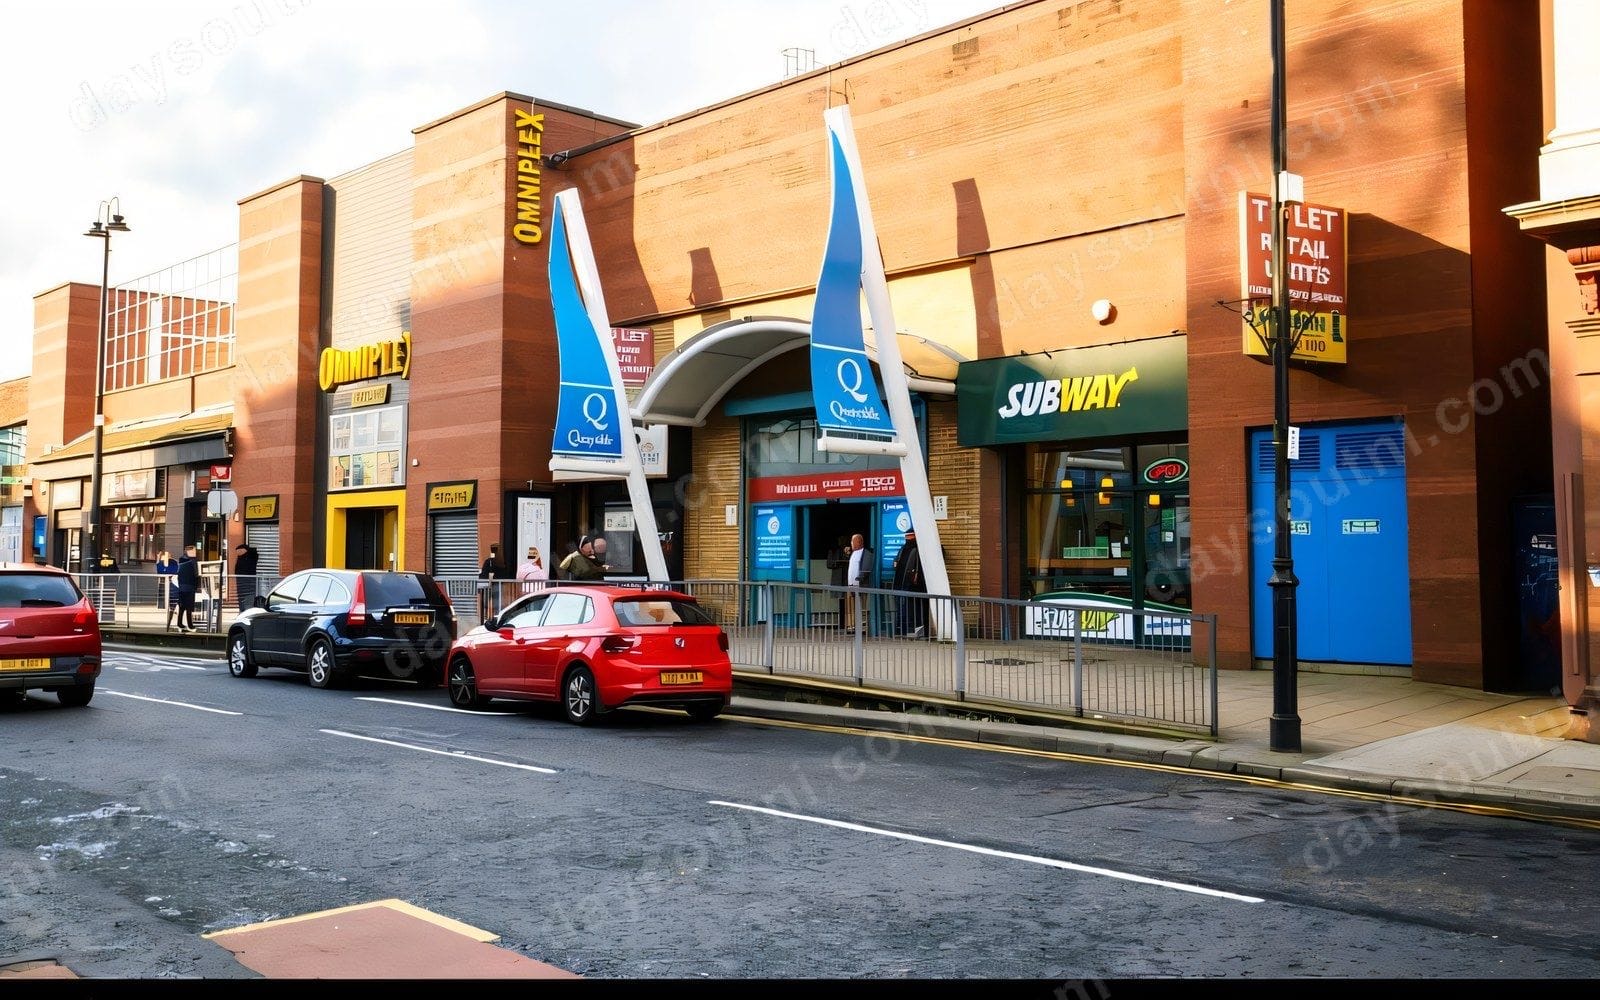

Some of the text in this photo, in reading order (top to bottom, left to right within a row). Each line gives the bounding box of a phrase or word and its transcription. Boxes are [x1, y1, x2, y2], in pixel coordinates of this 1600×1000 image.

[513, 108, 545, 243] OMNIPLEX
[1294, 204, 1338, 232] LET
[1261, 232, 1329, 259] RTAIL
[837, 358, 868, 403] Q
[998, 366, 1139, 420] SUBWAY
[583, 393, 609, 431] Q
